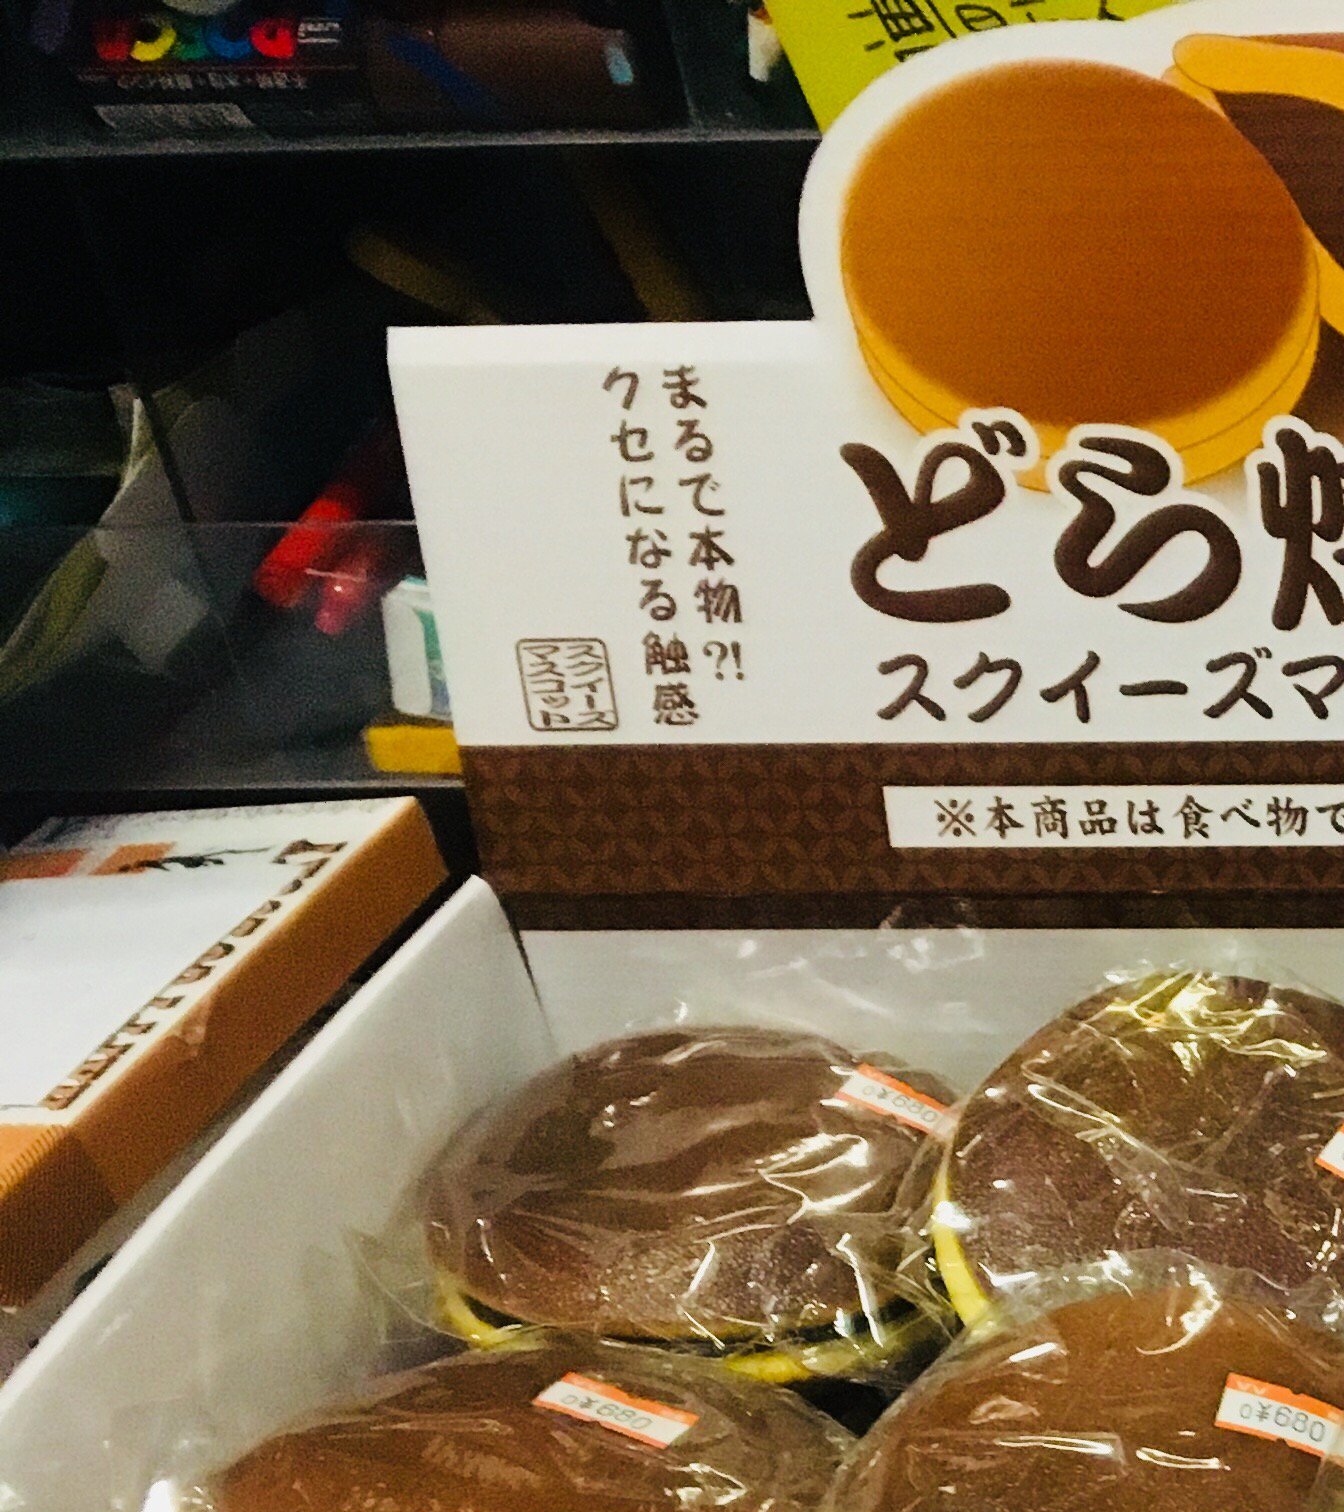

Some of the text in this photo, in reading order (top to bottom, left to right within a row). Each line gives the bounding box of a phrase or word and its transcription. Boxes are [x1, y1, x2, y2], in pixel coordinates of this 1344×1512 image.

[602, 366, 699, 727] クセになる触感
[662, 366, 745, 681] まるで本物?!
